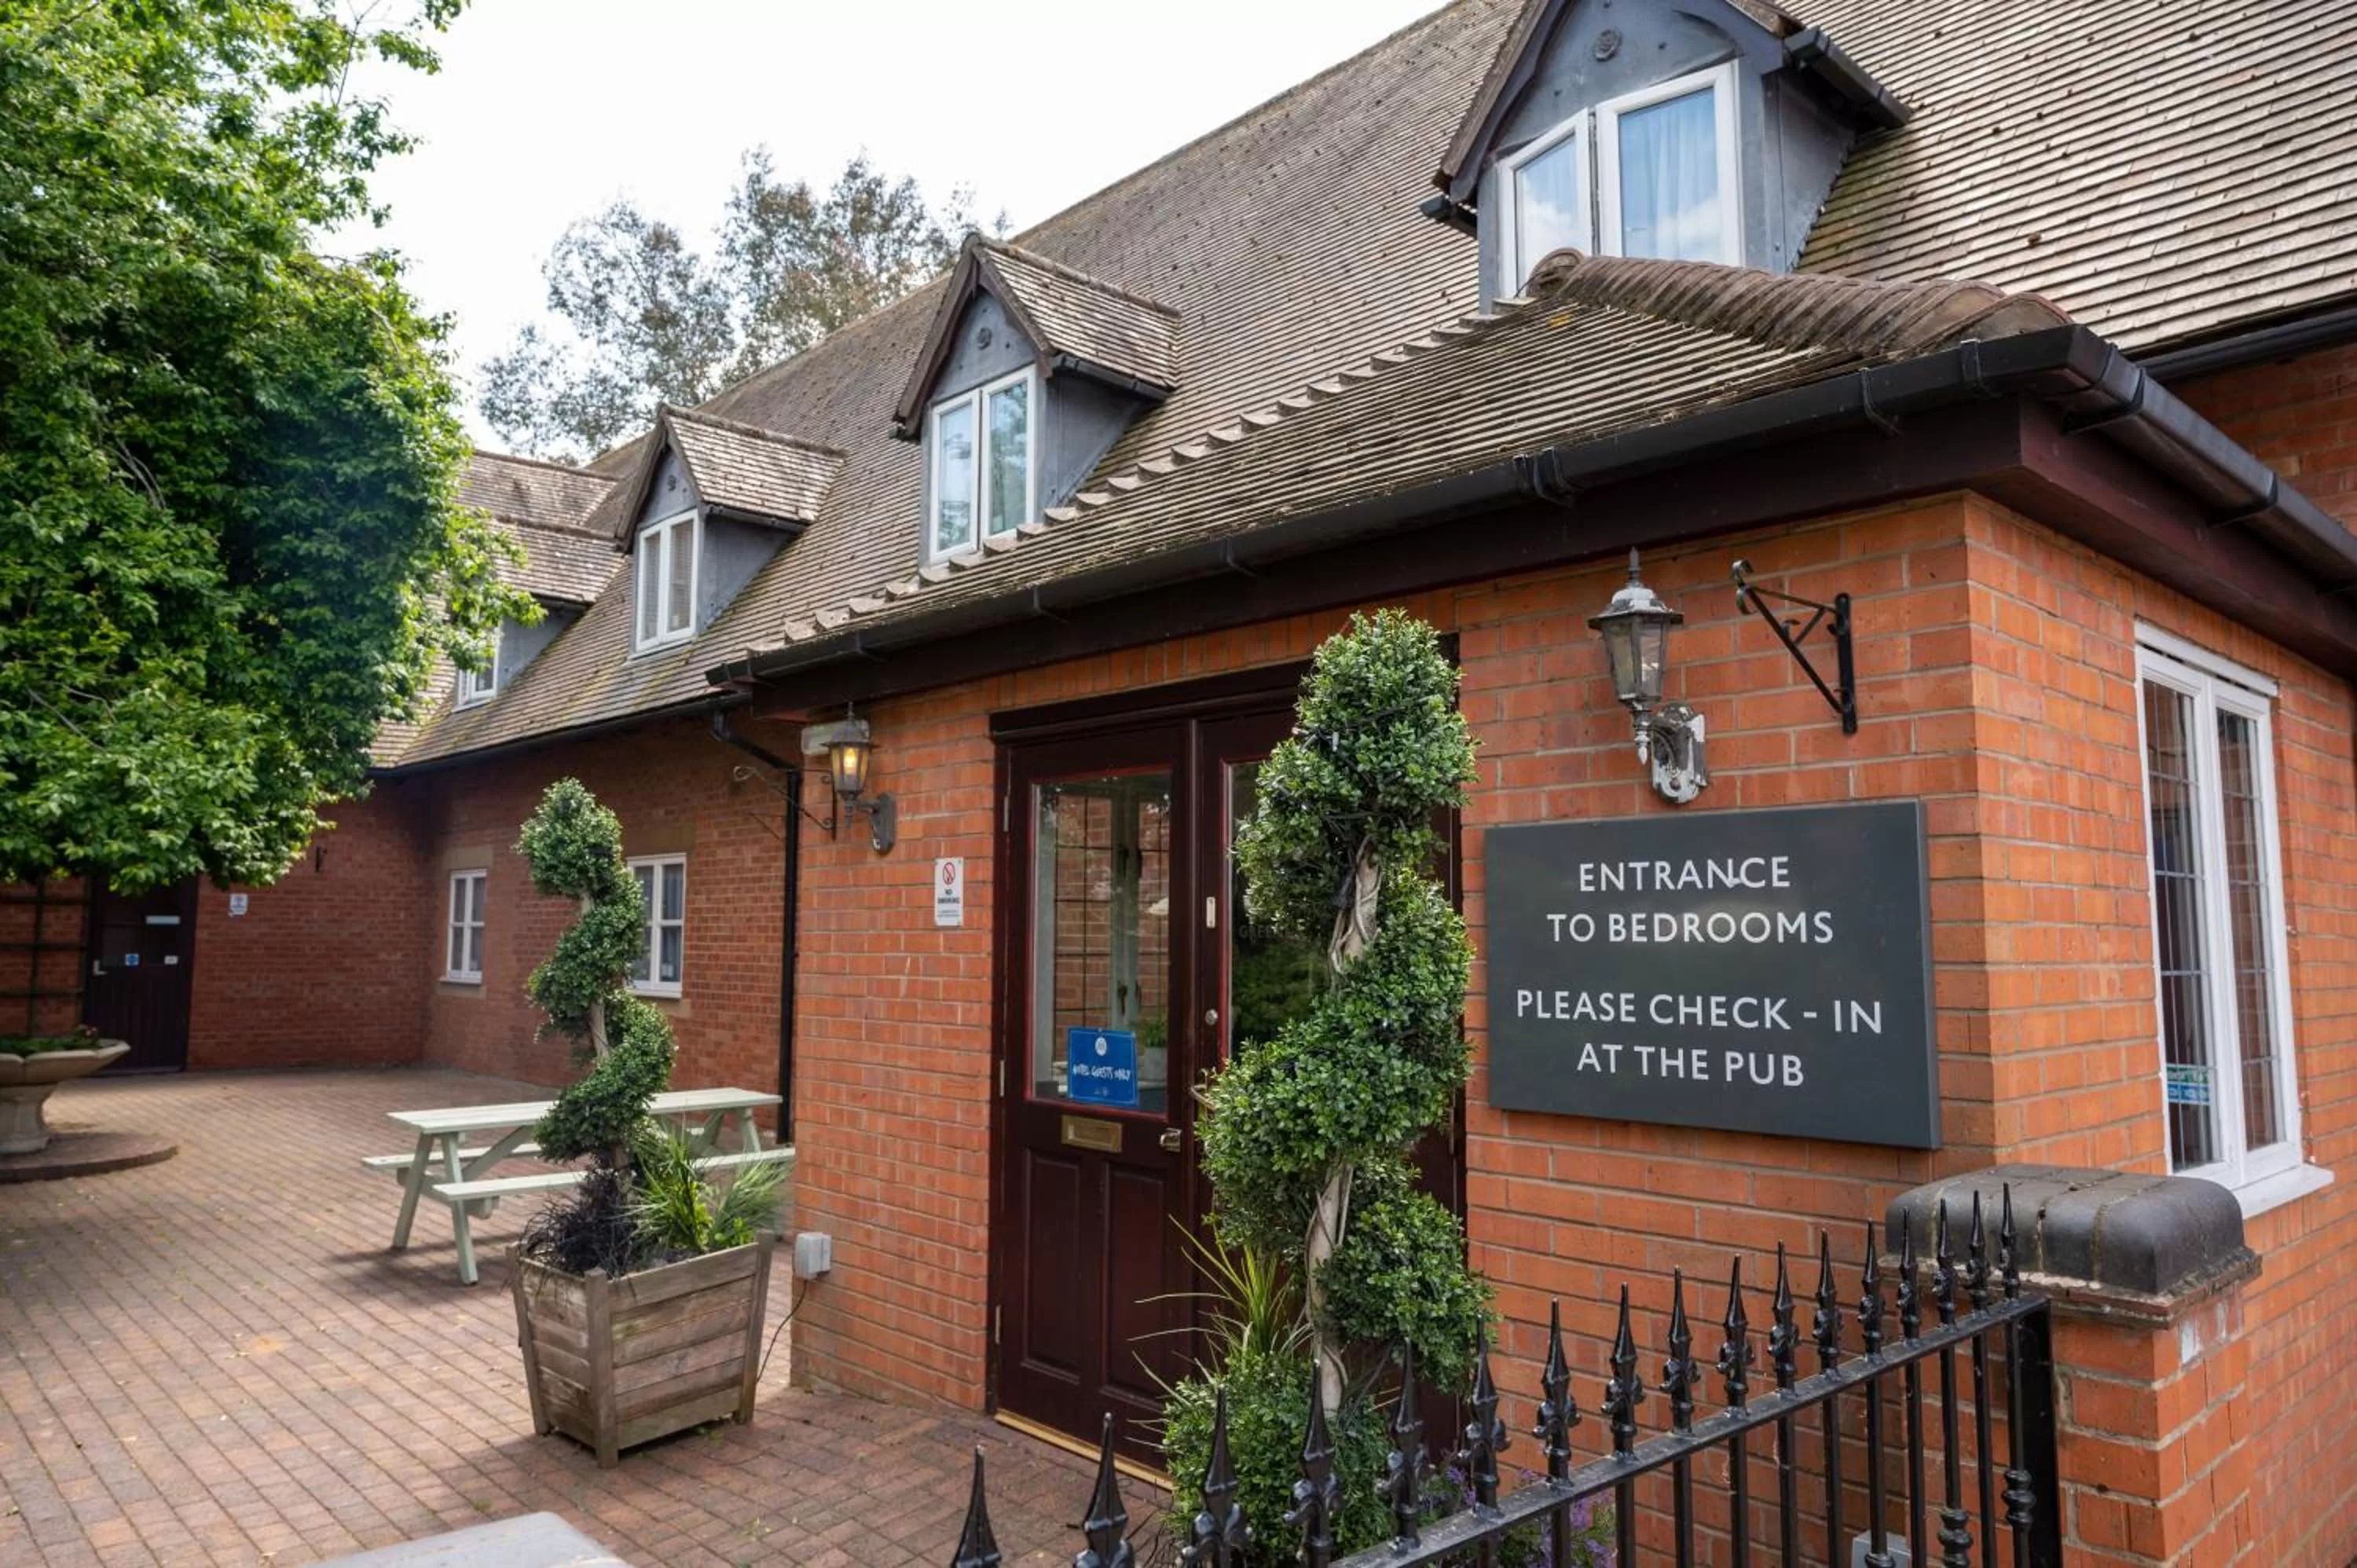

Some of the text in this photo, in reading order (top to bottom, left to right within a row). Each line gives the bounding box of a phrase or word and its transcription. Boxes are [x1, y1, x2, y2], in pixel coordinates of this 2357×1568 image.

[1579, 855, 1791, 892] ENTRANCE
[1546, 910, 1833, 943] TO BEDROOMS
[1517, 989, 1637, 1022] PLEASE
[1649, 994, 1791, 1030] CHECK
[1835, 1000, 1882, 1034] IN
[1577, 1042, 1804, 1086] AT THE PUB
